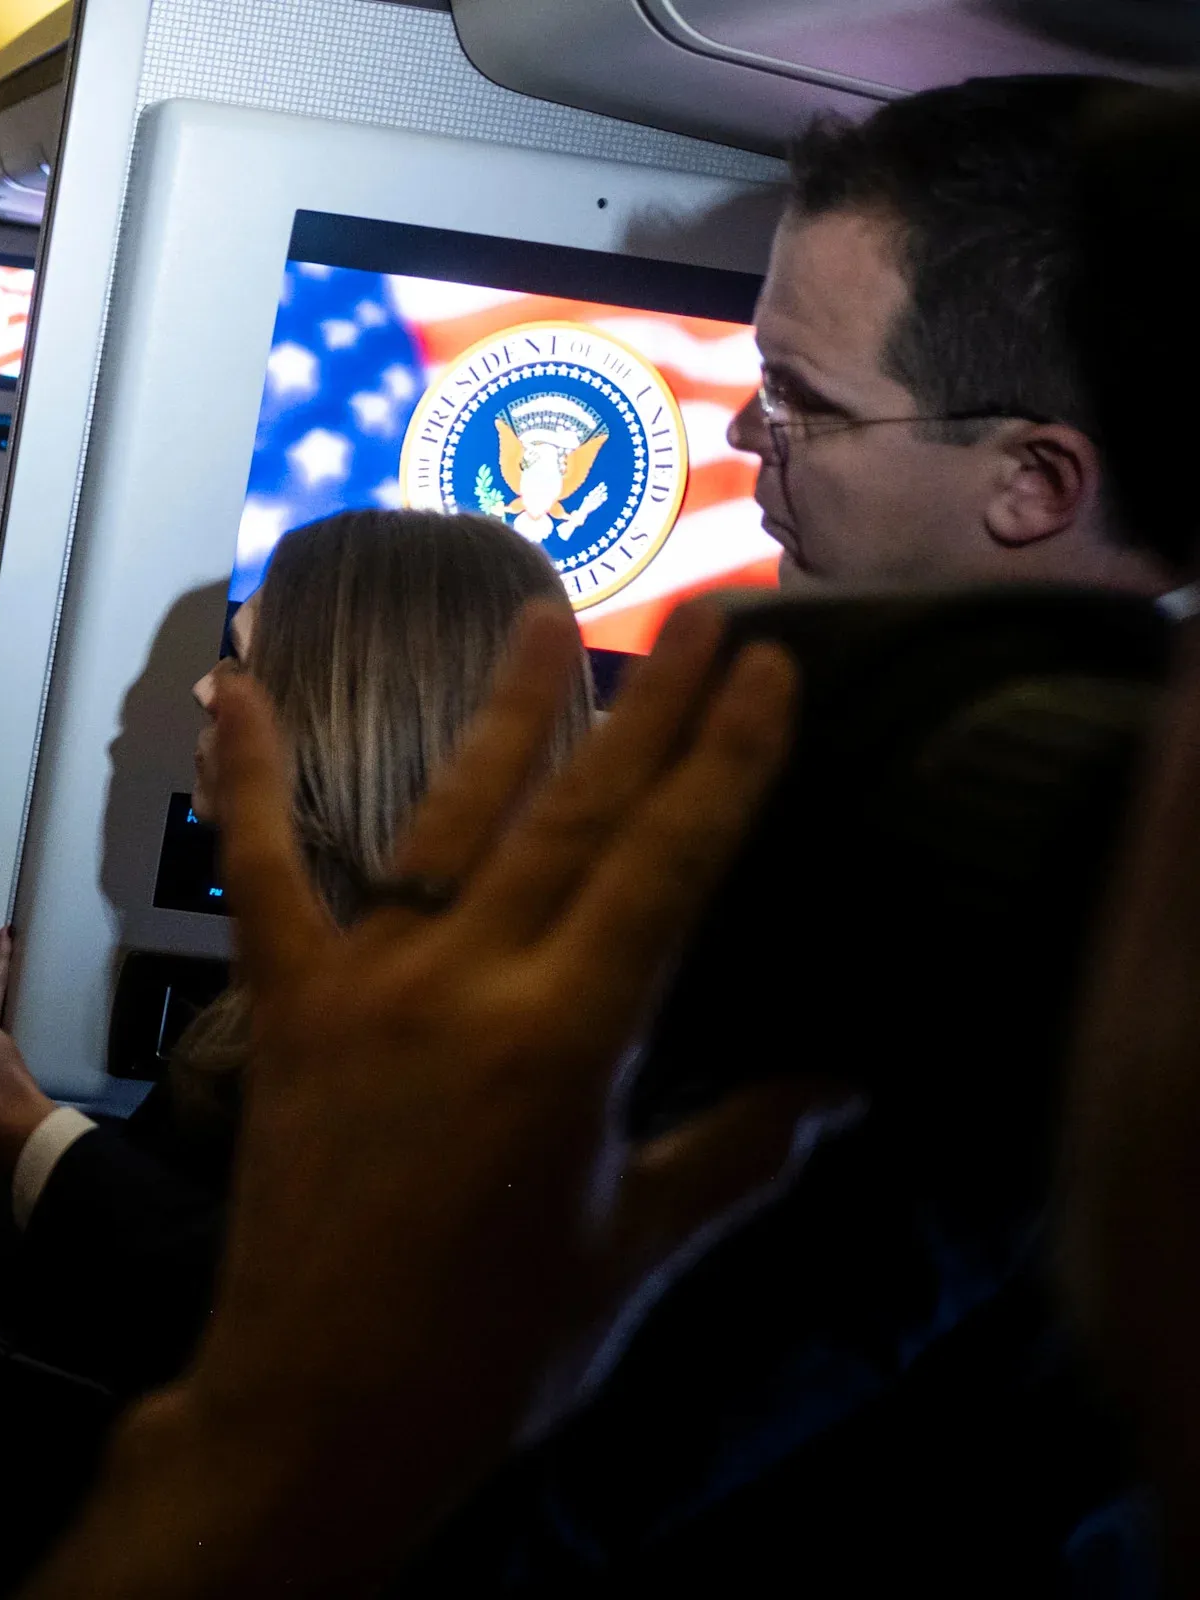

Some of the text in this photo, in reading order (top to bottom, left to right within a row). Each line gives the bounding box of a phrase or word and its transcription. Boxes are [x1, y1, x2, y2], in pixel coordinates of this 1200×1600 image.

[419, 334, 559, 445] PRESIDENT
[635, 384, 674, 504] UNITED
[567, 525, 649, 596] STATE
